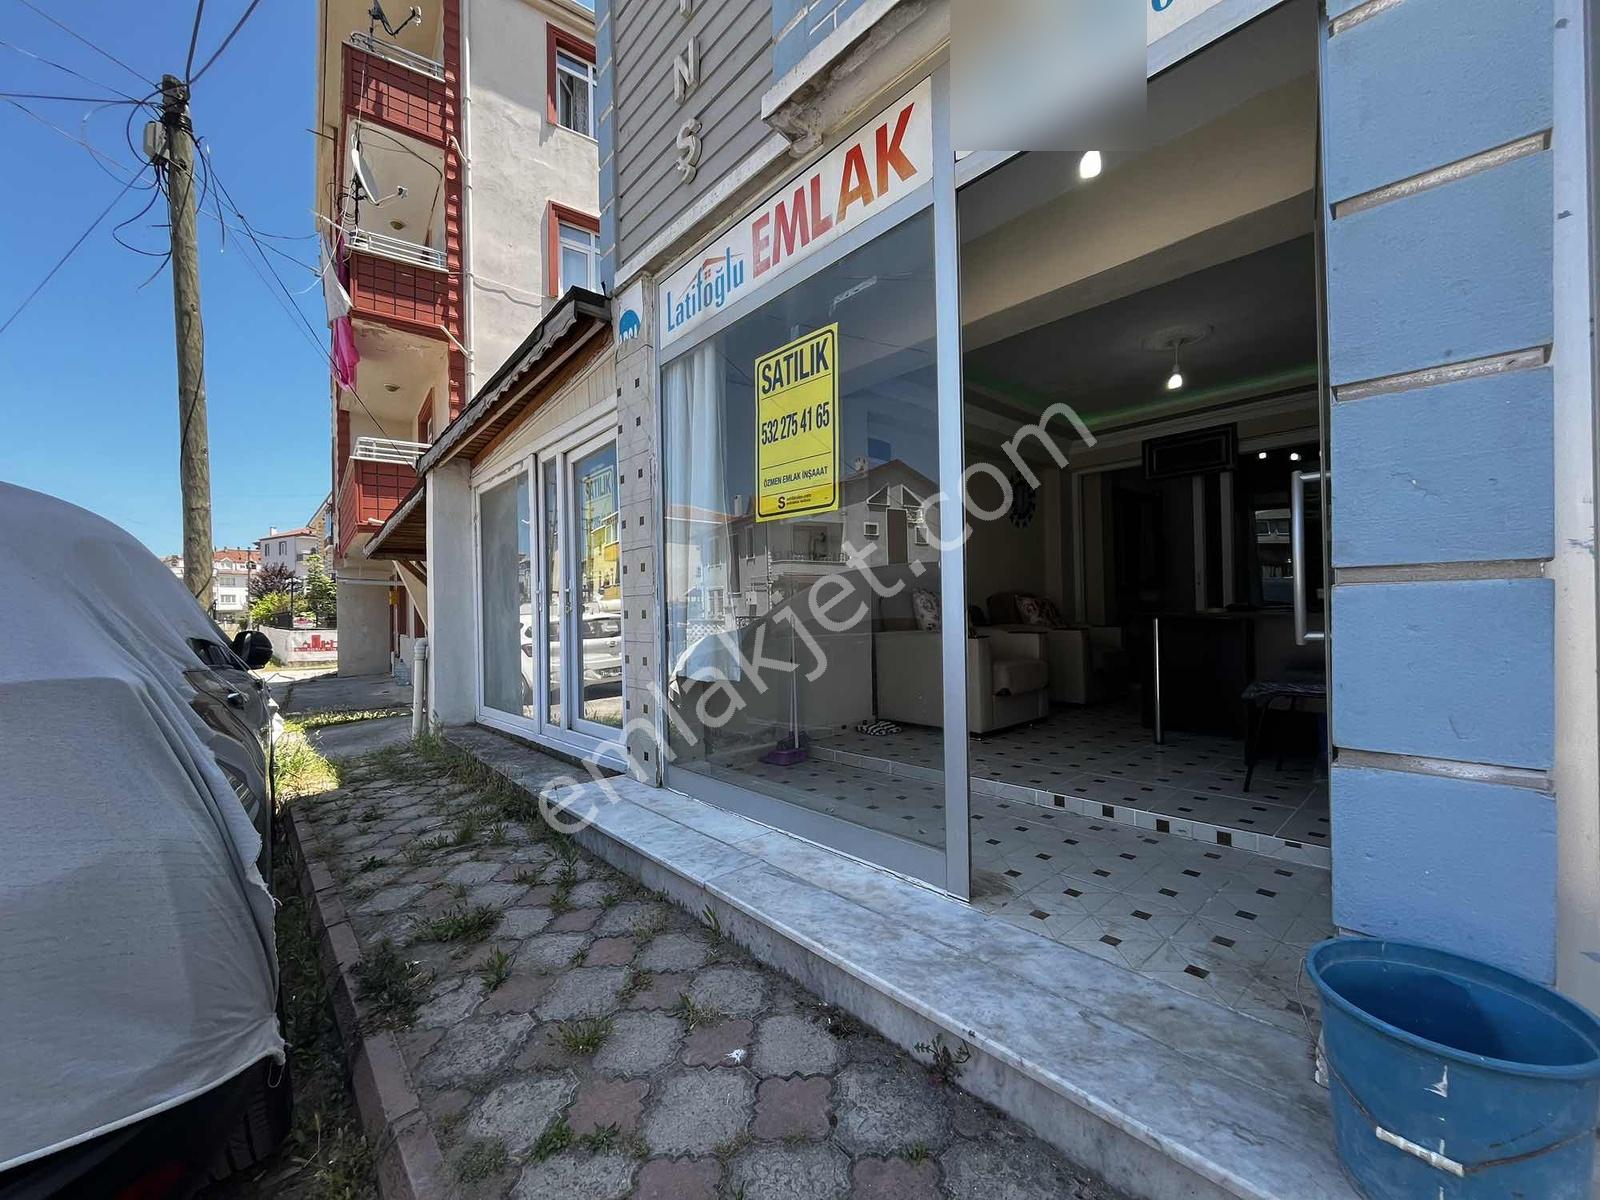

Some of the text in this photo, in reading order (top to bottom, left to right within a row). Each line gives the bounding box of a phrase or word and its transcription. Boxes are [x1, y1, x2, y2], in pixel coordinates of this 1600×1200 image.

[667, 102, 919, 333] Latifoğlu EMLAK
[761, 337, 829, 394] SATILIK
[761, 401, 830, 445] 532 275 41 65
[763, 476, 782, 488] ÖZMEN
[782, 472, 801, 484] EMLAK
